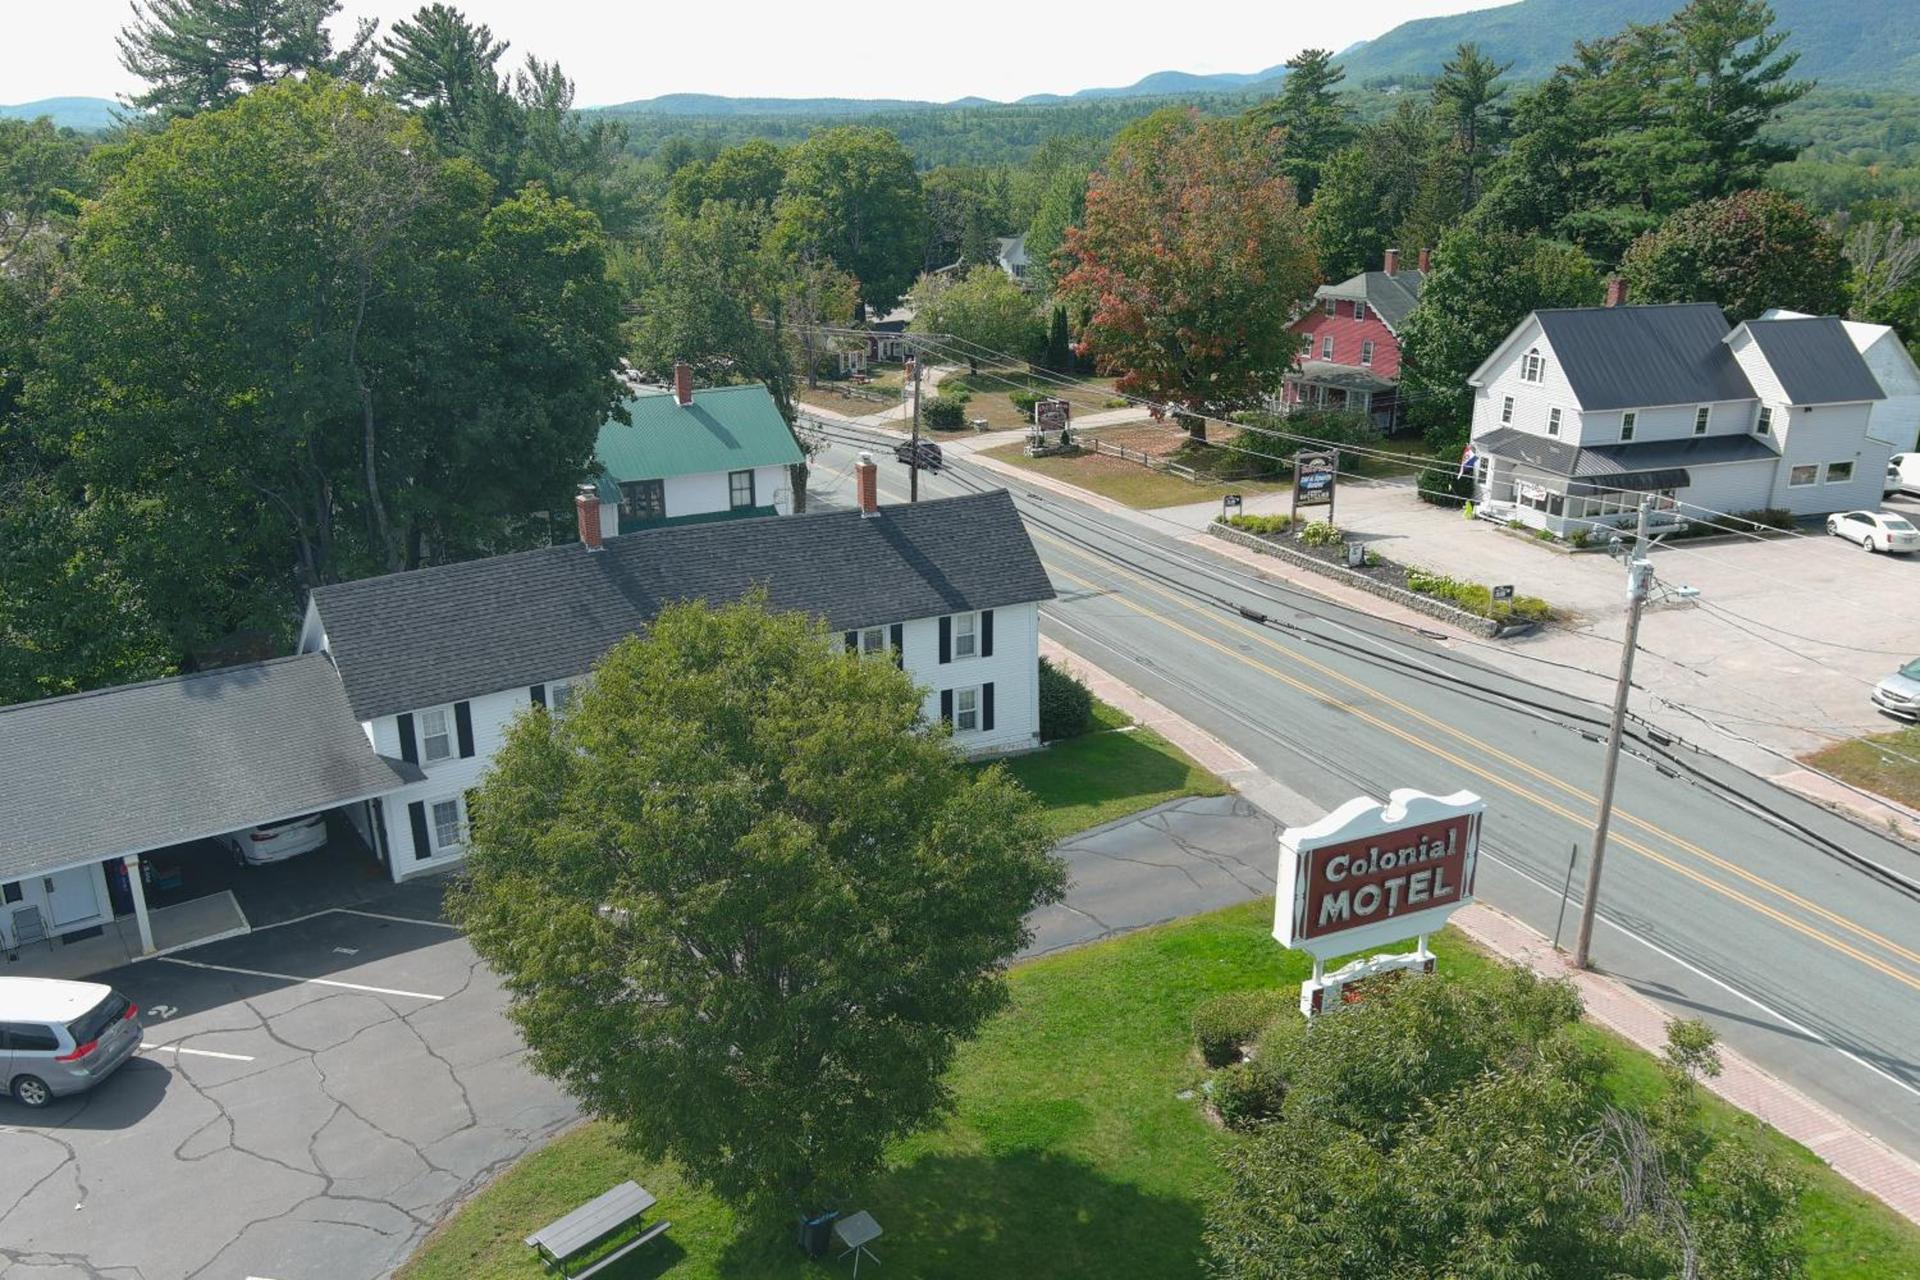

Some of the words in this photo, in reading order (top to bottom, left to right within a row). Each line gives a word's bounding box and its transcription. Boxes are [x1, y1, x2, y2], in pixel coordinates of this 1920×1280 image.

[1325, 828, 1457, 883] Colonial
[1318, 867, 1454, 928] MOTEL
[147, 1005, 178, 1018] 2
